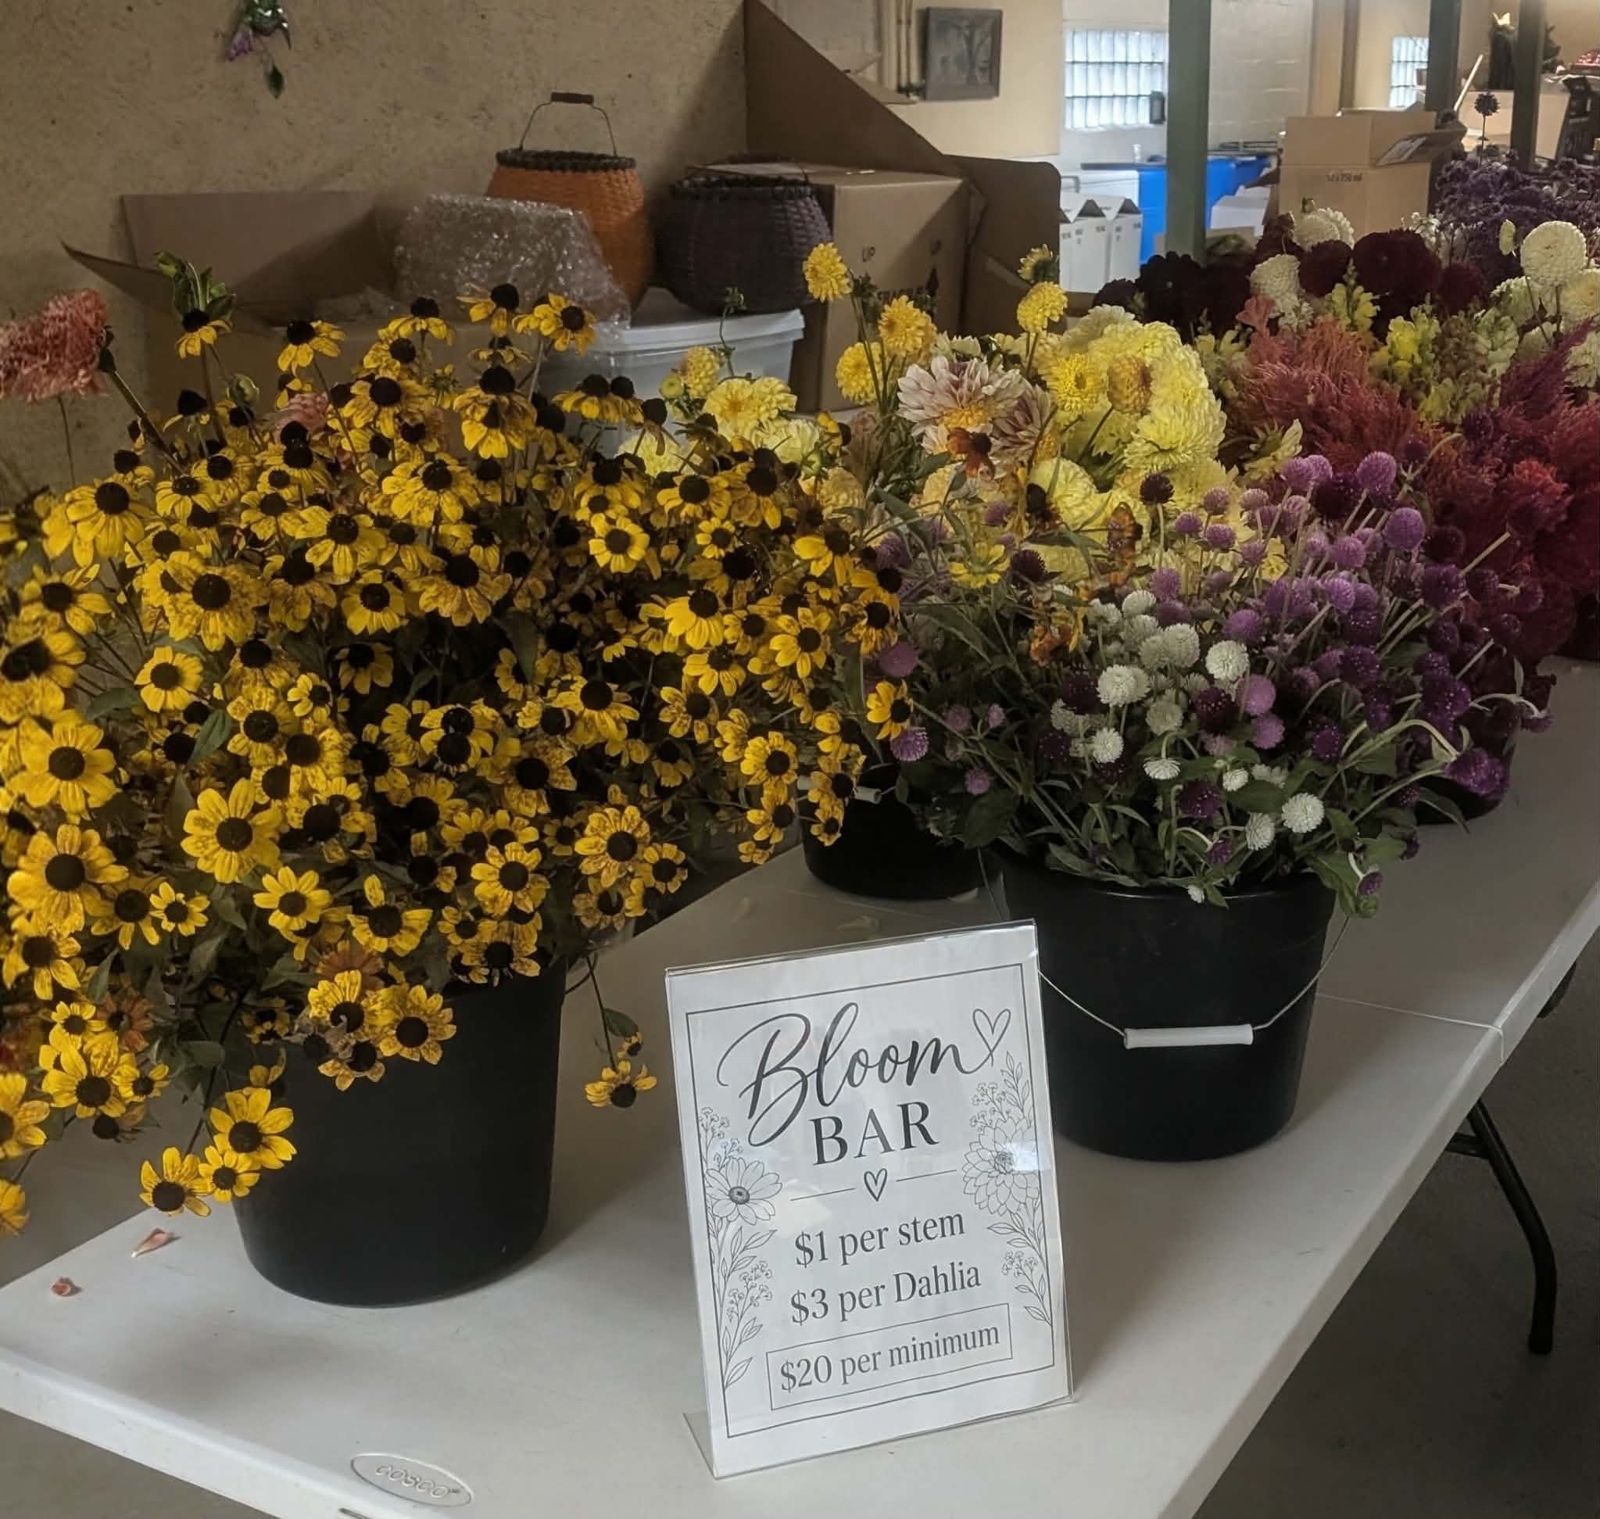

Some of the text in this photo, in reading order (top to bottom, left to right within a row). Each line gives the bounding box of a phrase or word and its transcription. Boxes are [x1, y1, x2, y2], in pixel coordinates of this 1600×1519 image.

[716, 1002, 990, 1148] Bloom
[809, 1101, 939, 1166] BAR
[795, 1212, 965, 1268] $1 per stem
[790, 1261, 982, 1326] $3 per Dahlia
[780, 1326, 1000, 1393] $20 per minimum
[375, 1465, 448, 1498] COSCO
